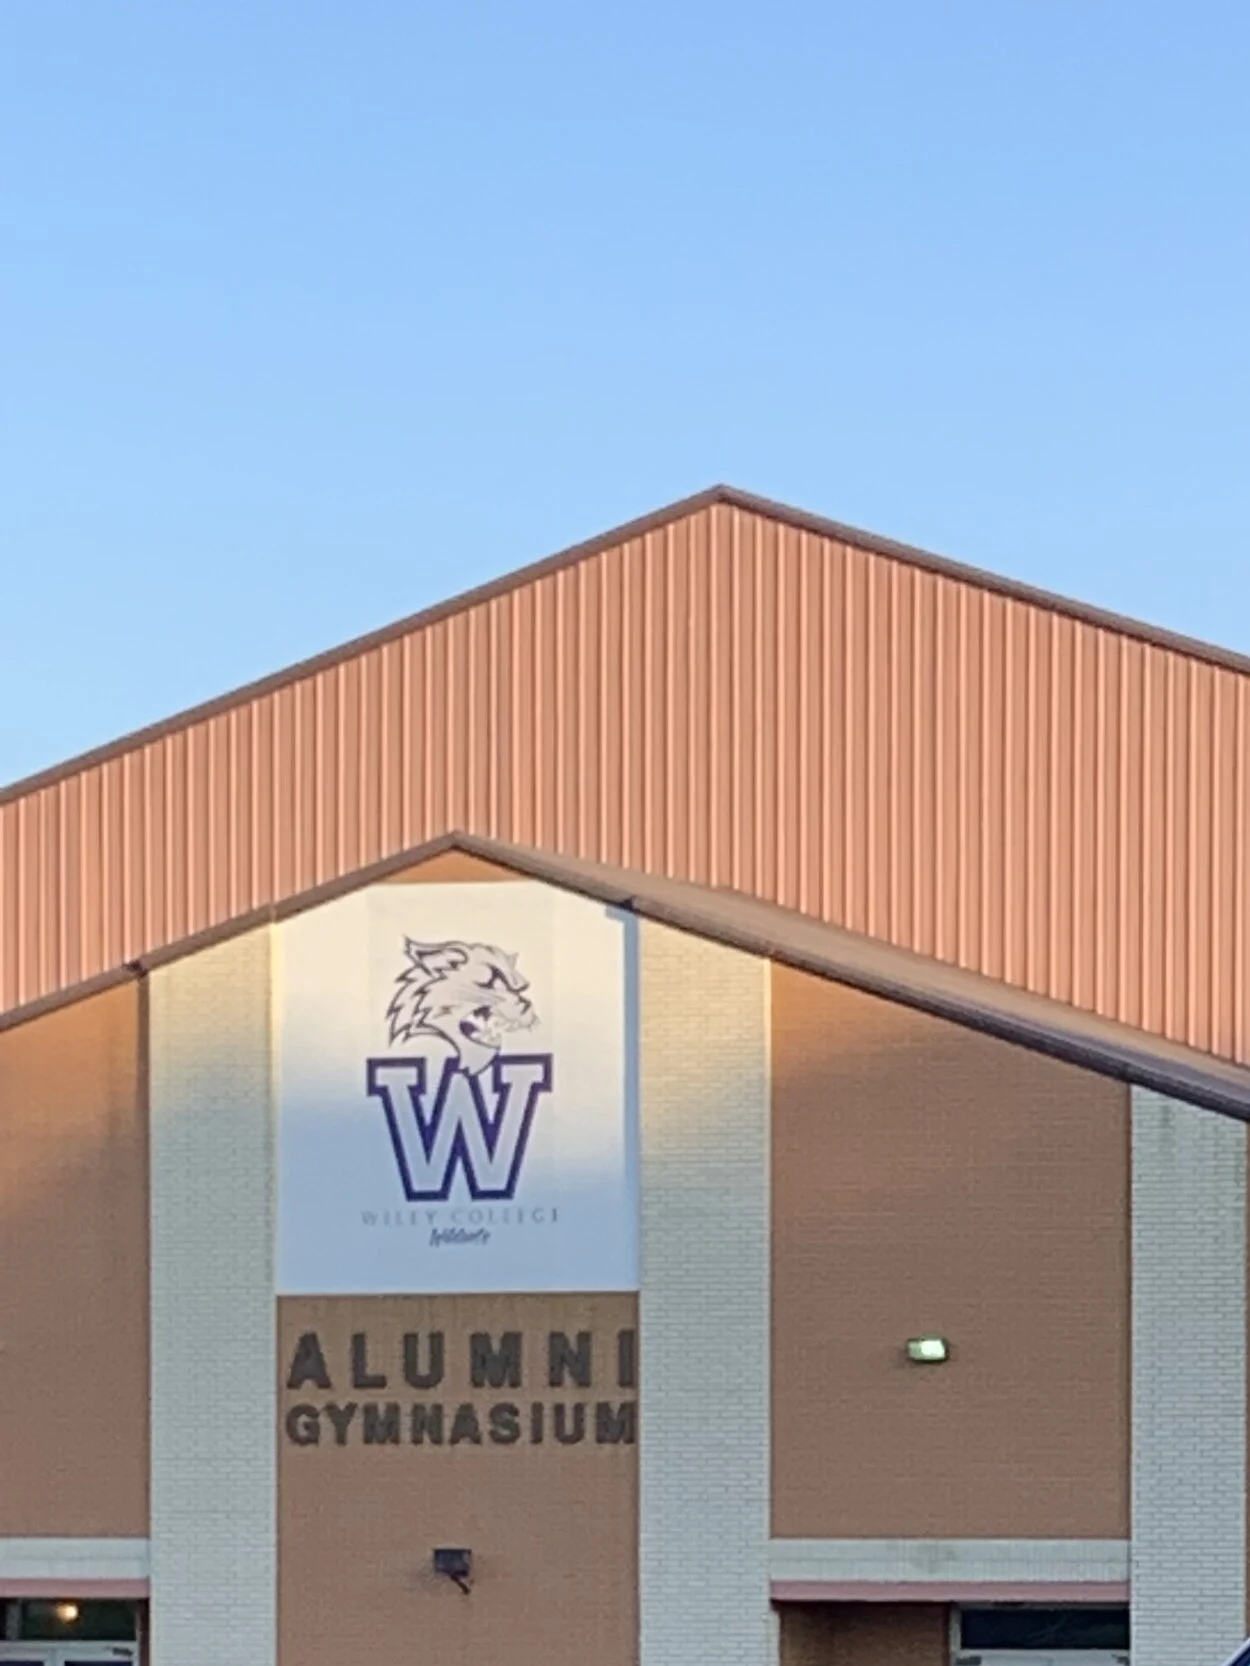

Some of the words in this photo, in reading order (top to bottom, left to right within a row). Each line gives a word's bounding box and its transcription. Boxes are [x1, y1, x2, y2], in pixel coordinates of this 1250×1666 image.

[366, 1053, 553, 1202] W
[286, 1329, 637, 1390] ALUMNI
[285, 1402, 637, 1446] GYMNASIUM
